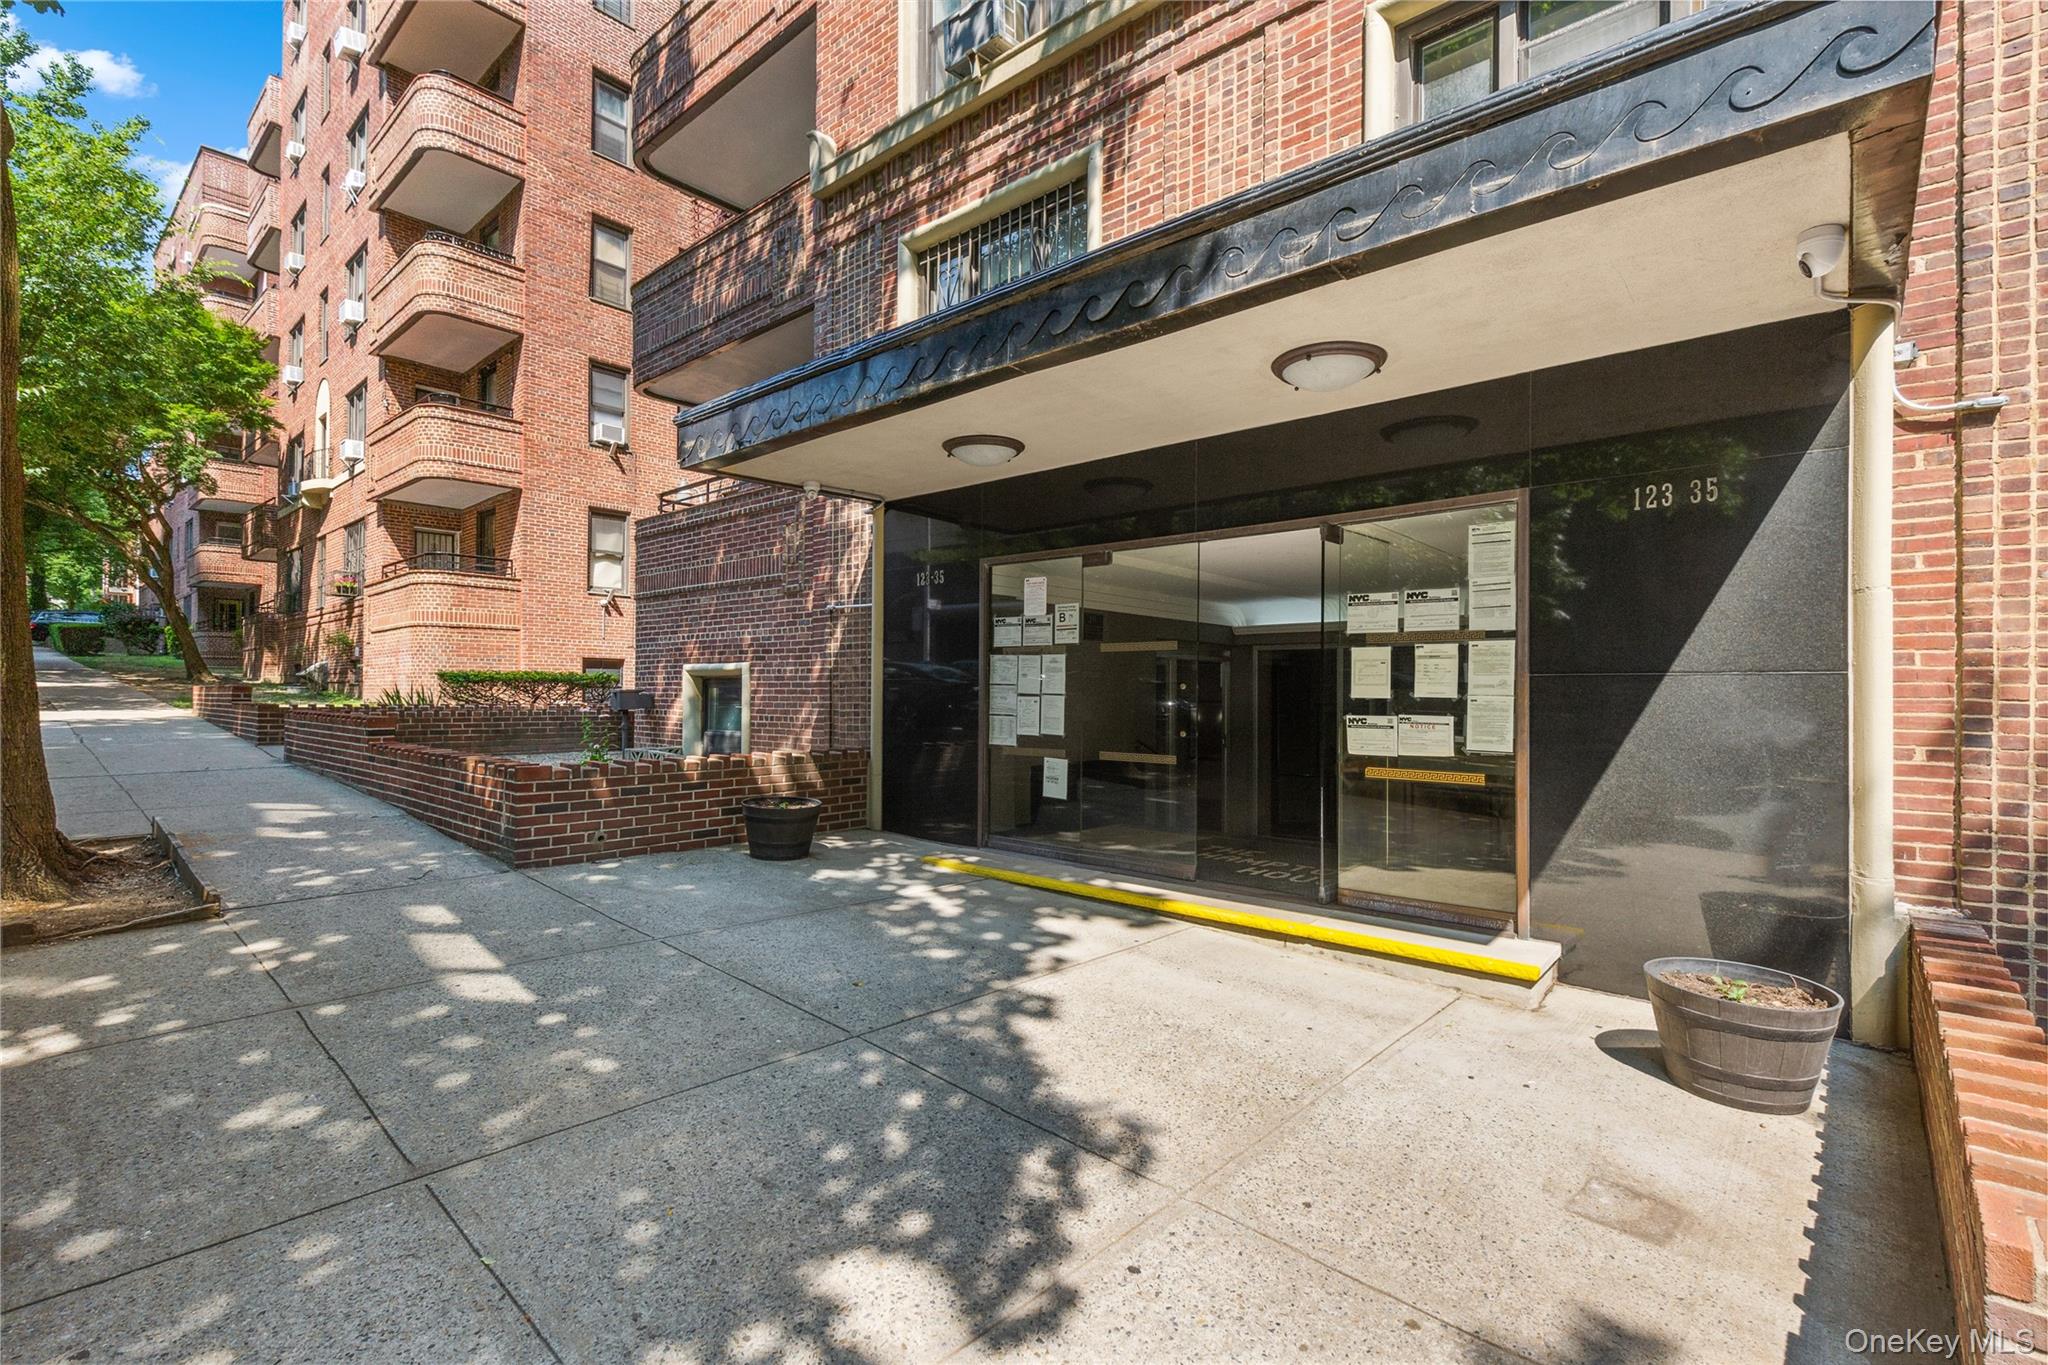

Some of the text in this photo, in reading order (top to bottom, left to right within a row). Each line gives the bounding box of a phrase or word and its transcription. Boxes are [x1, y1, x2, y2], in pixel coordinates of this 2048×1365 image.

[1633, 477, 1719, 511] 123 35
[1348, 594, 1370, 603] NYC
[1406, 591, 1428, 600] NYC
[1059, 612, 1067, 623] B
[1348, 717, 1368, 725] NYC
[1197, 851, 1335, 875] HAMPTO
